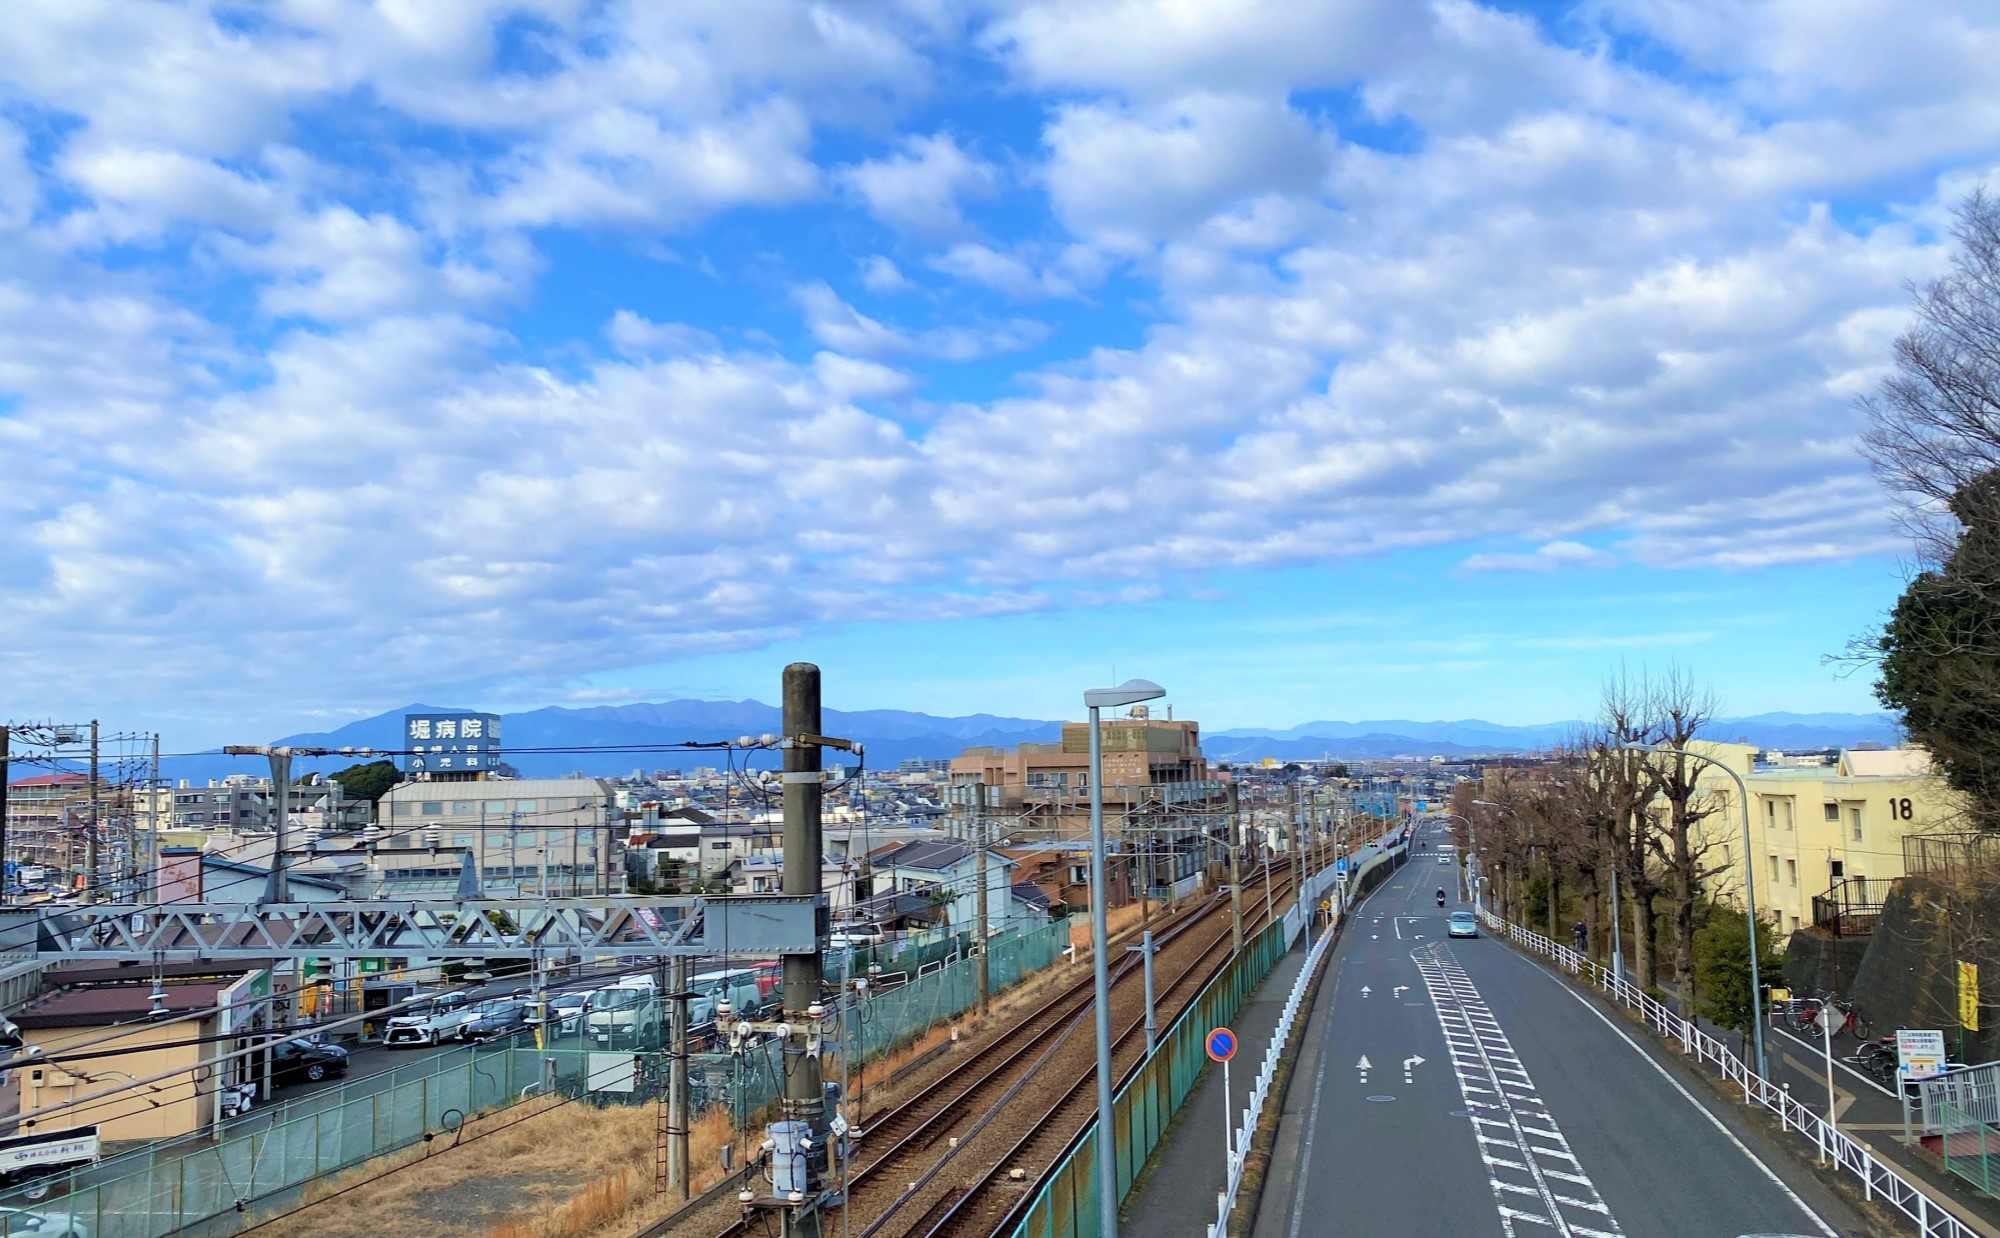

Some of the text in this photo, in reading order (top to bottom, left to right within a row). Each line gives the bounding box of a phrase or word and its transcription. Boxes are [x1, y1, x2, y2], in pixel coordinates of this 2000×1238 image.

[410, 719, 482, 739] 堀病院
[413, 745, 478, 756] 産婦人科
[412, 757, 478, 768] 小児科
[1889, 798, 1913, 820] 18
